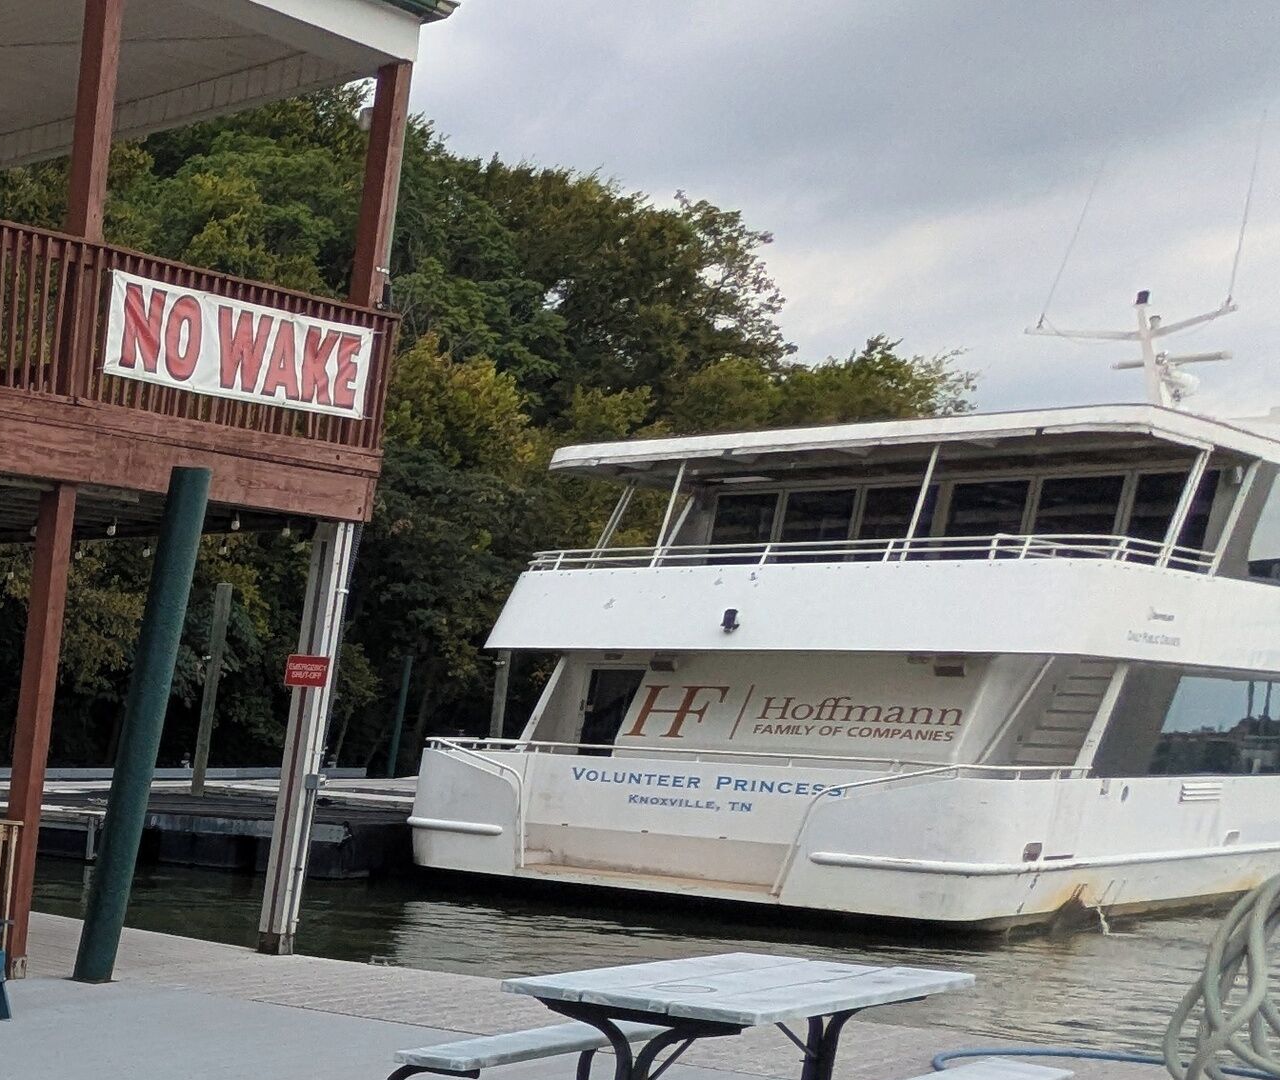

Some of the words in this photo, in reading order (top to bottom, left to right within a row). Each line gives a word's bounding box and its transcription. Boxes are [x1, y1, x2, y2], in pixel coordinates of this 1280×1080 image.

[118, 282, 203, 382] NO
[218, 304, 363, 410] WAKE
[288, 663, 327, 671] EMERGENCY
[622, 684, 730, 739] HF
[757, 695, 964, 728] Hoffmann
[753, 723, 816, 738] FAMILY
[818, 725, 842, 737] OF
[846, 727, 956, 743] COMPANIES
[729, 800, 753, 813] TN
